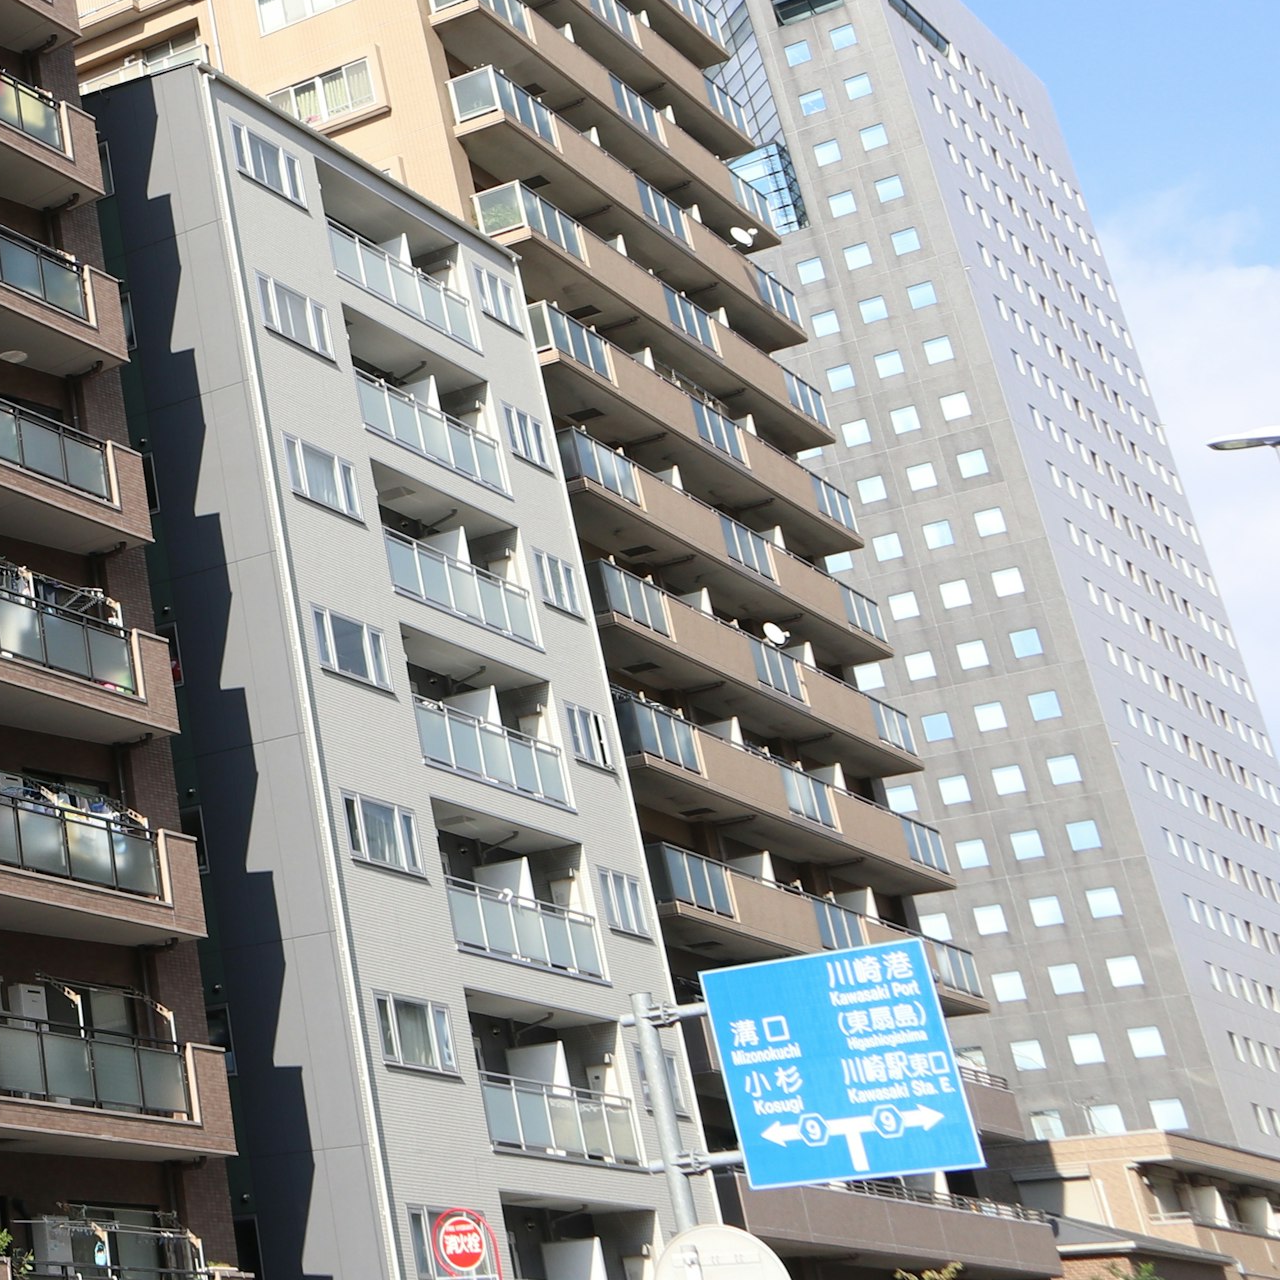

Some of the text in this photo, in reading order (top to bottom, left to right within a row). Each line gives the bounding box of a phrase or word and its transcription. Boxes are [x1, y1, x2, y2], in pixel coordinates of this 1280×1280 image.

[826, 950, 914, 989] 川崎港
[829, 979, 921, 1007] Kawasaki Port
[729, 1015, 791, 1047] 溝口
[846, 1030, 928, 1051] Higashiogishima
[731, 1042, 802, 1065] Mizonokuchi
[841, 1050, 951, 1085] 川崎駅東口
[745, 1065, 804, 1098] 小杉
[846, 1076, 956, 1104] Kawasaki Sta. E.
[753, 1095, 805, 1116] Kosugi
[805, 1119, 821, 1140] 9
[879, 1111, 897, 1132] 9
[444, 1232, 482, 1255] 消火栓
